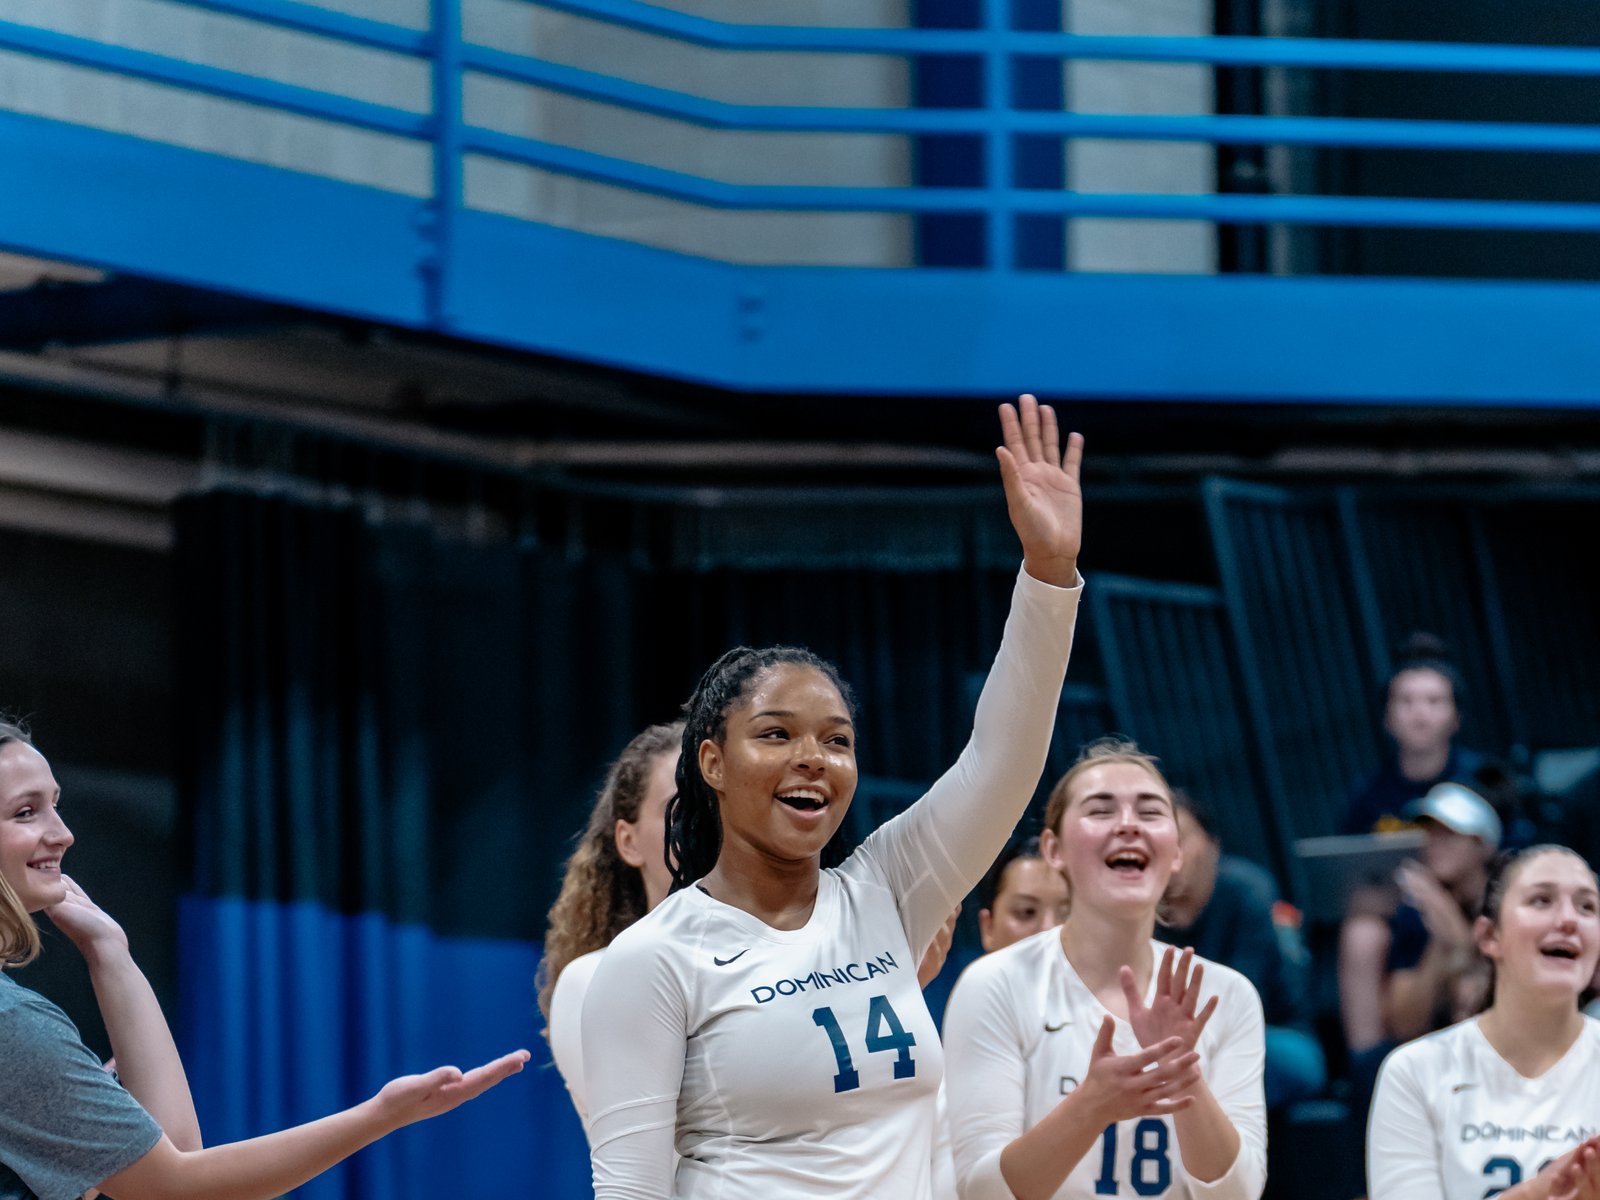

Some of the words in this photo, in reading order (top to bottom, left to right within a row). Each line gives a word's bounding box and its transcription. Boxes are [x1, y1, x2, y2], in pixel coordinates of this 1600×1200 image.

[750, 951, 900, 1004] DOMINICAN
[811, 994, 917, 1094] 14
[1094, 1117, 1173, 1197] 18
